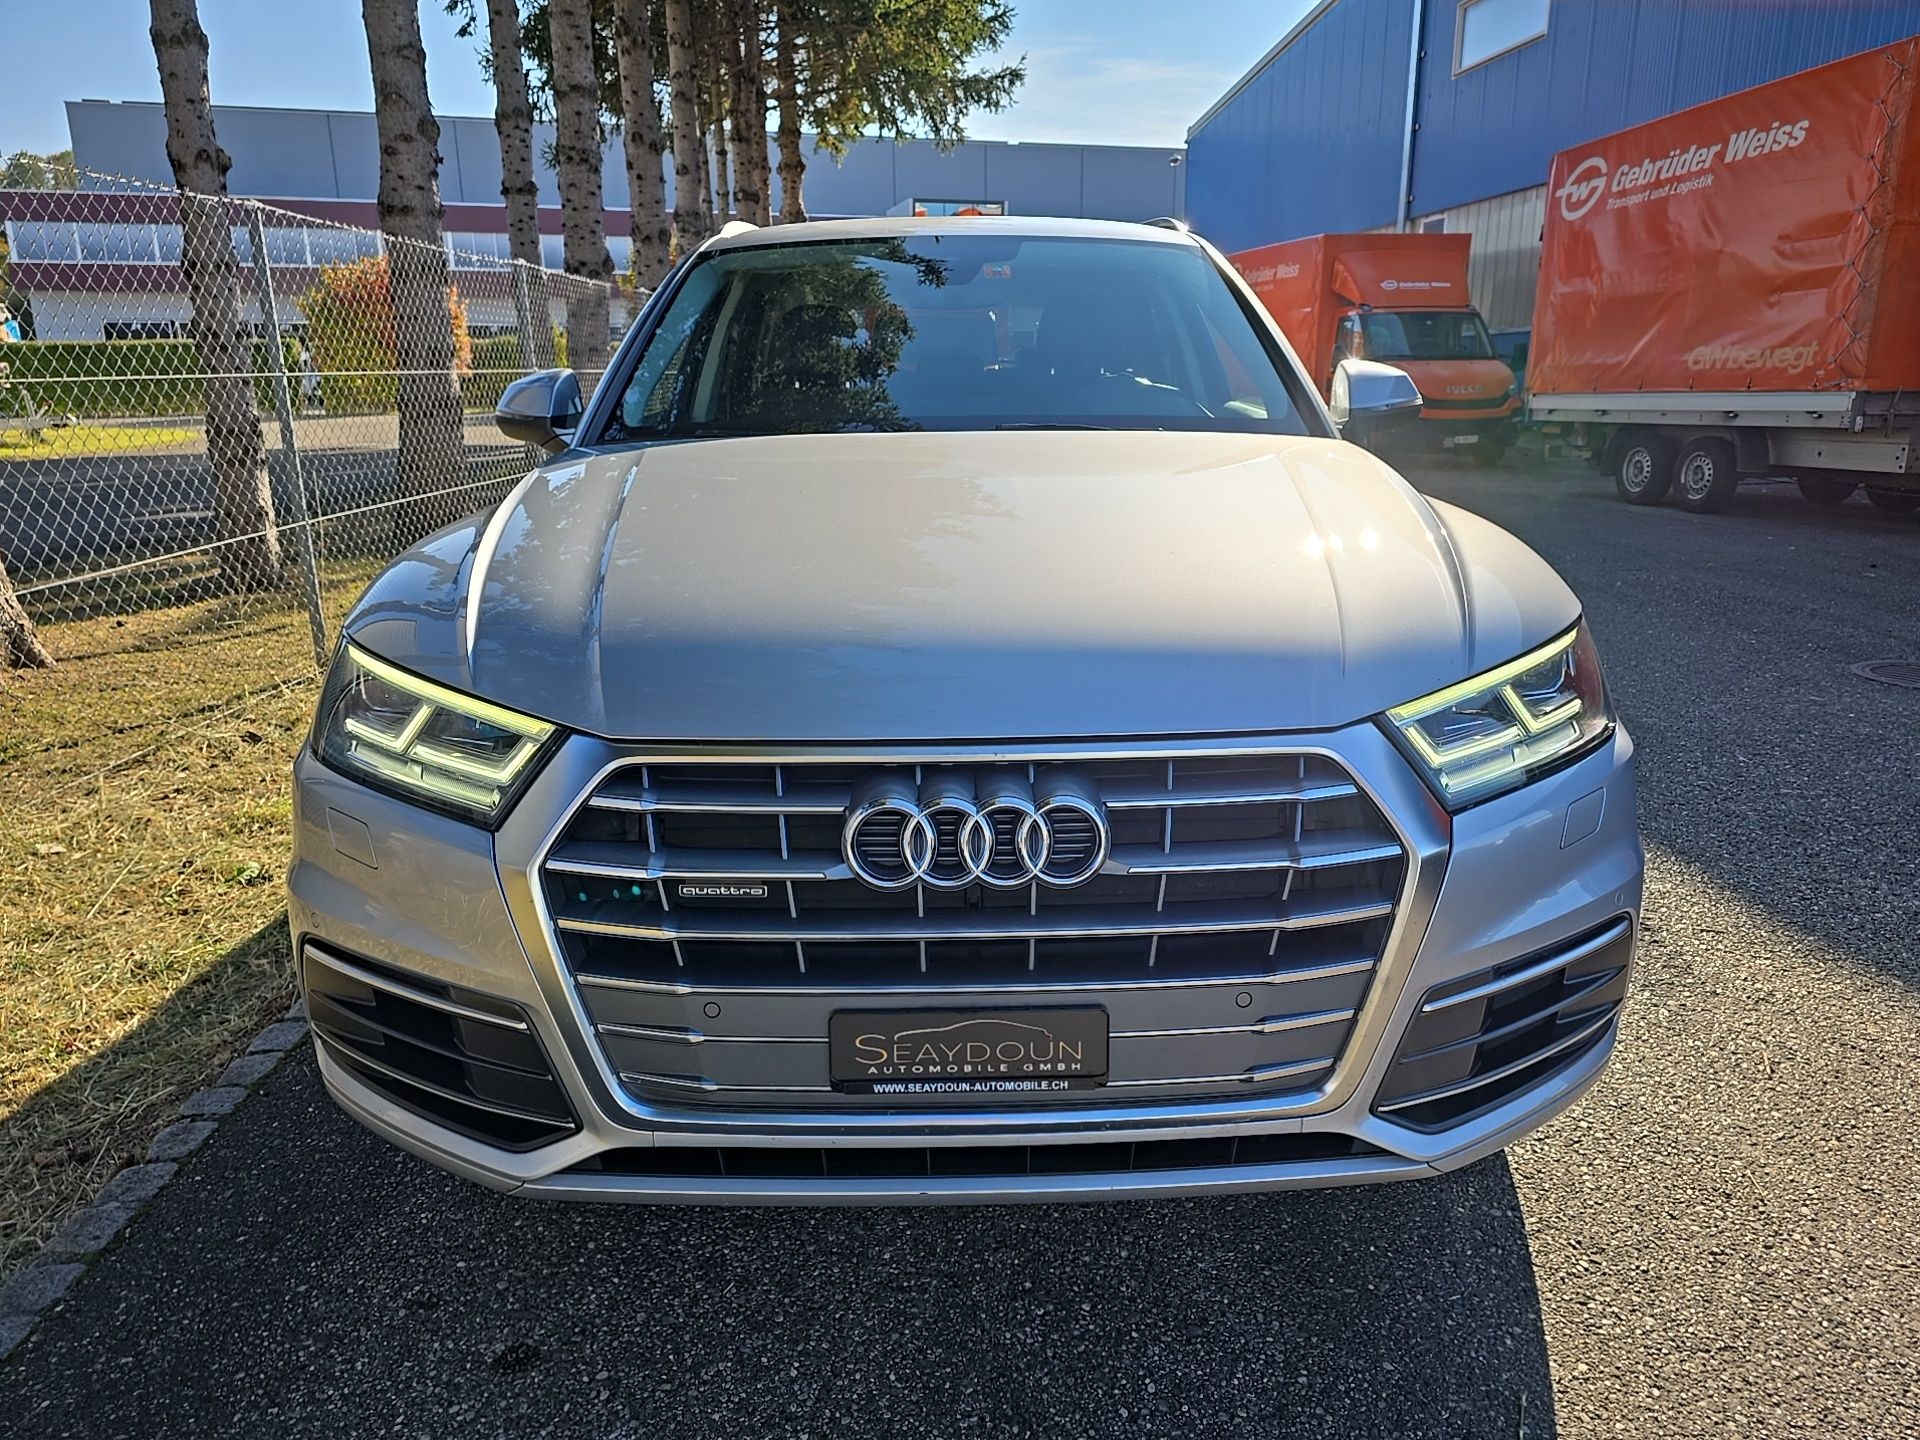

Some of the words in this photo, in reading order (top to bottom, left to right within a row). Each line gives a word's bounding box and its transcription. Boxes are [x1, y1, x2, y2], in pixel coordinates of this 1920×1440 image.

[1611, 143, 1722, 193] Gebrüder
[1723, 119, 1809, 164] Weiss
[1606, 191, 1651, 210] Transport
[1651, 186, 1669, 199] und
[1671, 174, 1715, 196] Logistik
[682, 886, 763, 896] quattro
[867, 1063, 1009, 1075] AUTOMOBILE
[1023, 1062, 1081, 1072] GMBH
[873, 1081, 1069, 1094] WWW.SEAYDOUN-AUTOMOBILE.CH
